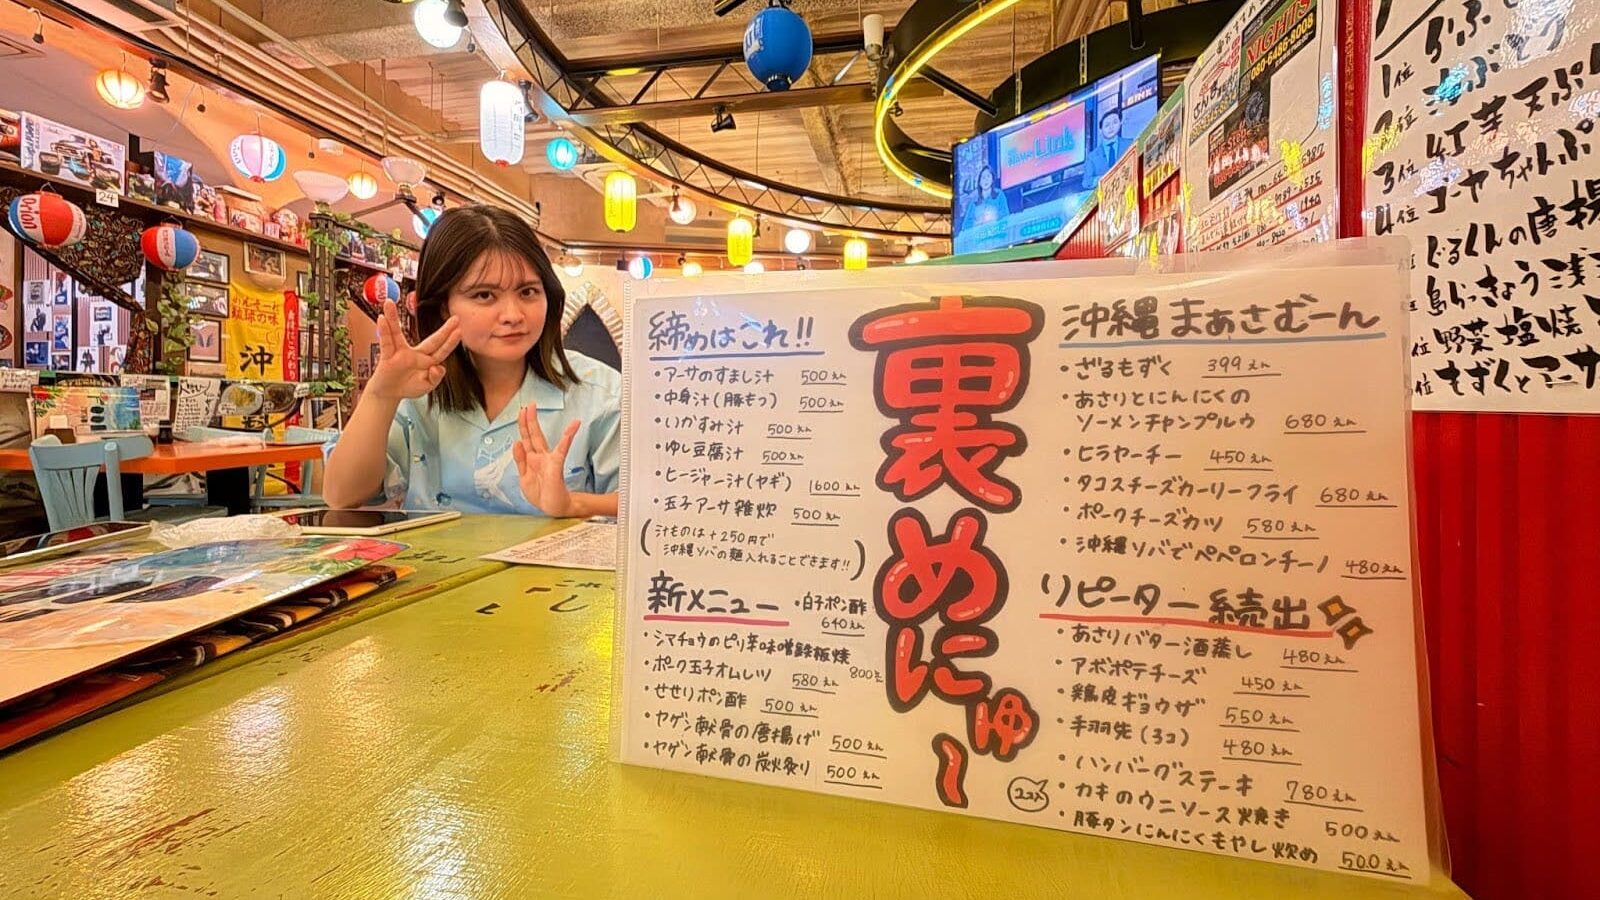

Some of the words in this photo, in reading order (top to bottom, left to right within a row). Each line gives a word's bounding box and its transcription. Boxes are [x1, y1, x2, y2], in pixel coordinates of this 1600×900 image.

[20, 197, 40, 229] Orion
[664, 366, 774, 385] アーサのすまし汁
[1075, 354, 1172, 380] ざるもずく
[1074, 388, 1251, 409] あさりとにんにくの
[665, 416, 744, 436] いかすみ汁
[665, 440, 744, 462] ゆし豆腐汁
[1079, 443, 1182, 465] ヒラヤーチー
[1078, 474, 1299, 505] タコスチーズカーリーフライ
[1077, 502, 1224, 533] ポークチーズカツ
[1075, 534, 1329, 574] 沖縄ソバでペペロンチーノ
[648, 570, 779, 614] 新メニュー
[803, 592, 867, 616] 白子ポン酢
[1041, 573, 1311, 631] リピーター続出
[1072, 623, 1253, 660] あさりバター酒蒸し
[655, 683, 747, 709] せせりポン酢
[1071, 684, 1207, 718] 鶏皮ギョウザ
[656, 710, 820, 747] ヤゲン軟骨の唐揚げ
[1076, 755, 1254, 797] ハンバーグステーキ
[1075, 782, 1290, 829] カキのウニソース焼き
